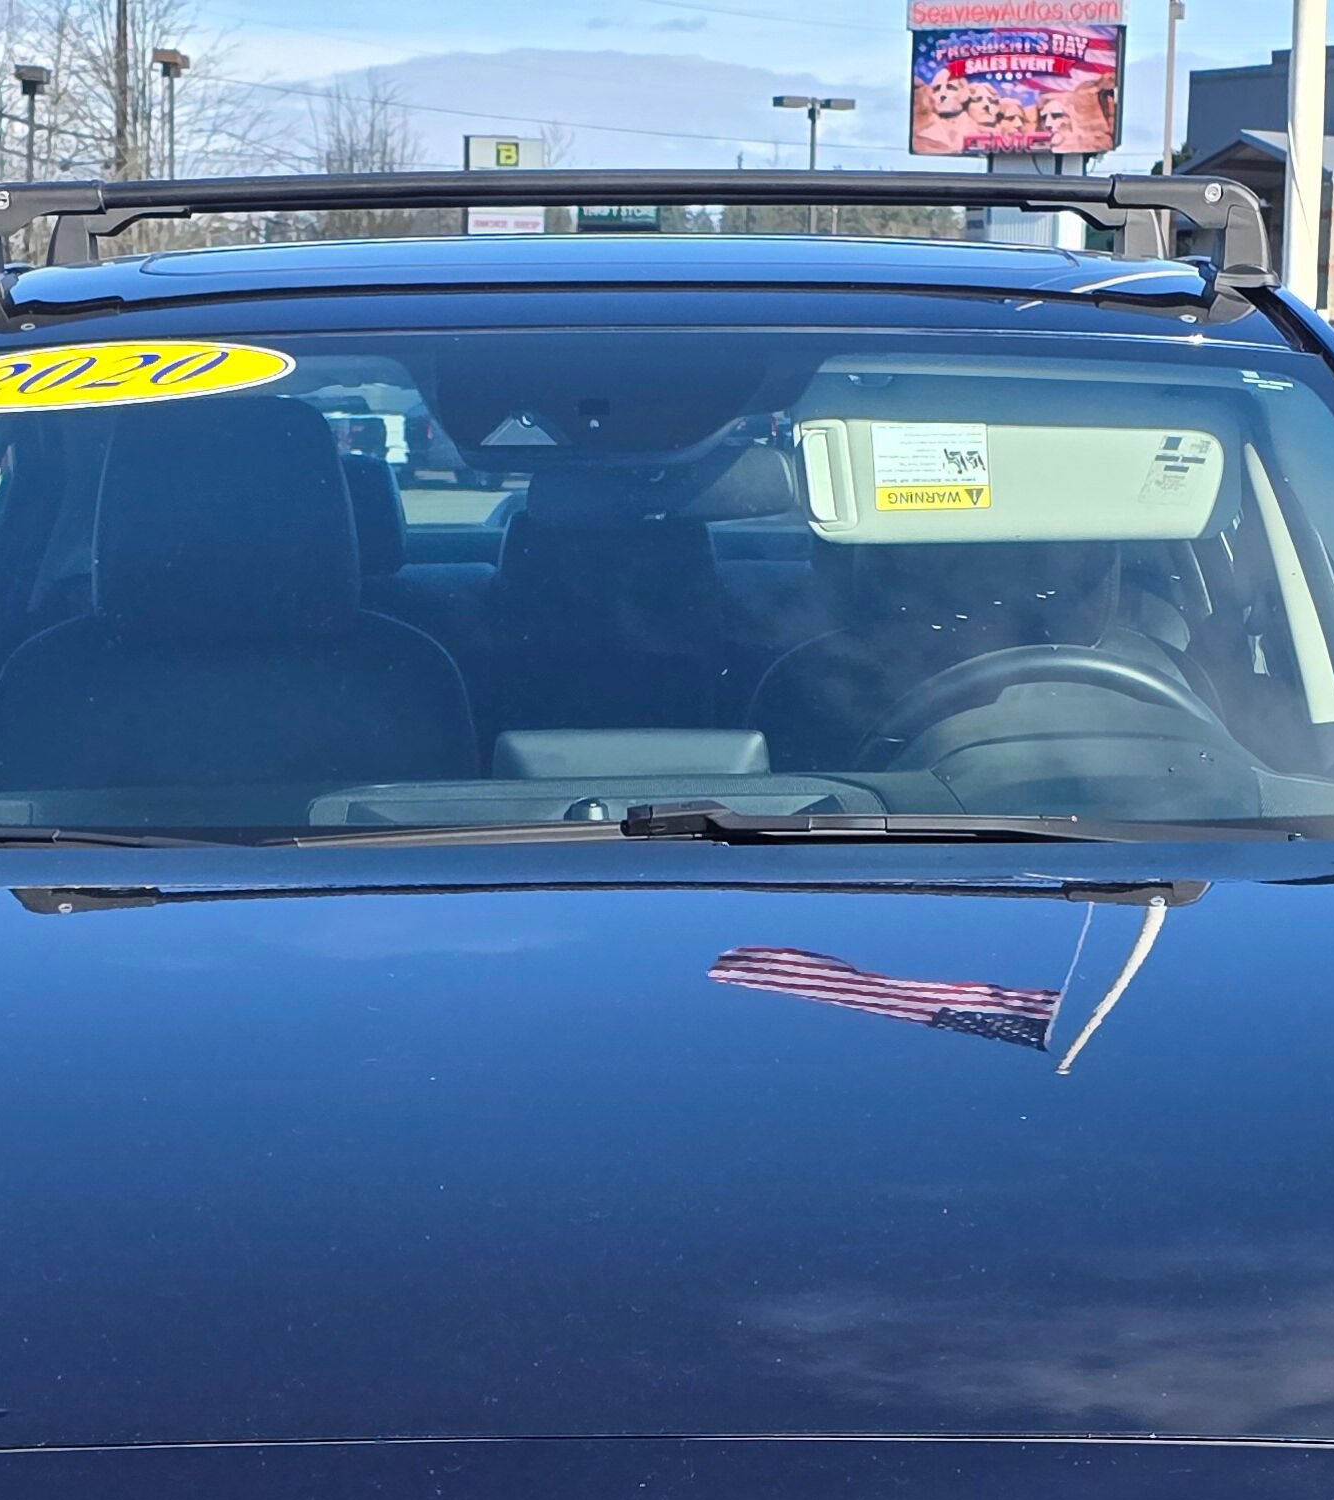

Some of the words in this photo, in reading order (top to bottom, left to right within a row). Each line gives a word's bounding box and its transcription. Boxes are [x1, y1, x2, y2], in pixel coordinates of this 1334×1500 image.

[1051, 33, 1088, 58] DAY
[965, 57, 1009, 73] SALES
[1010, 57, 1056, 72] EVENT
[887, 491, 962, 505] WARNING
